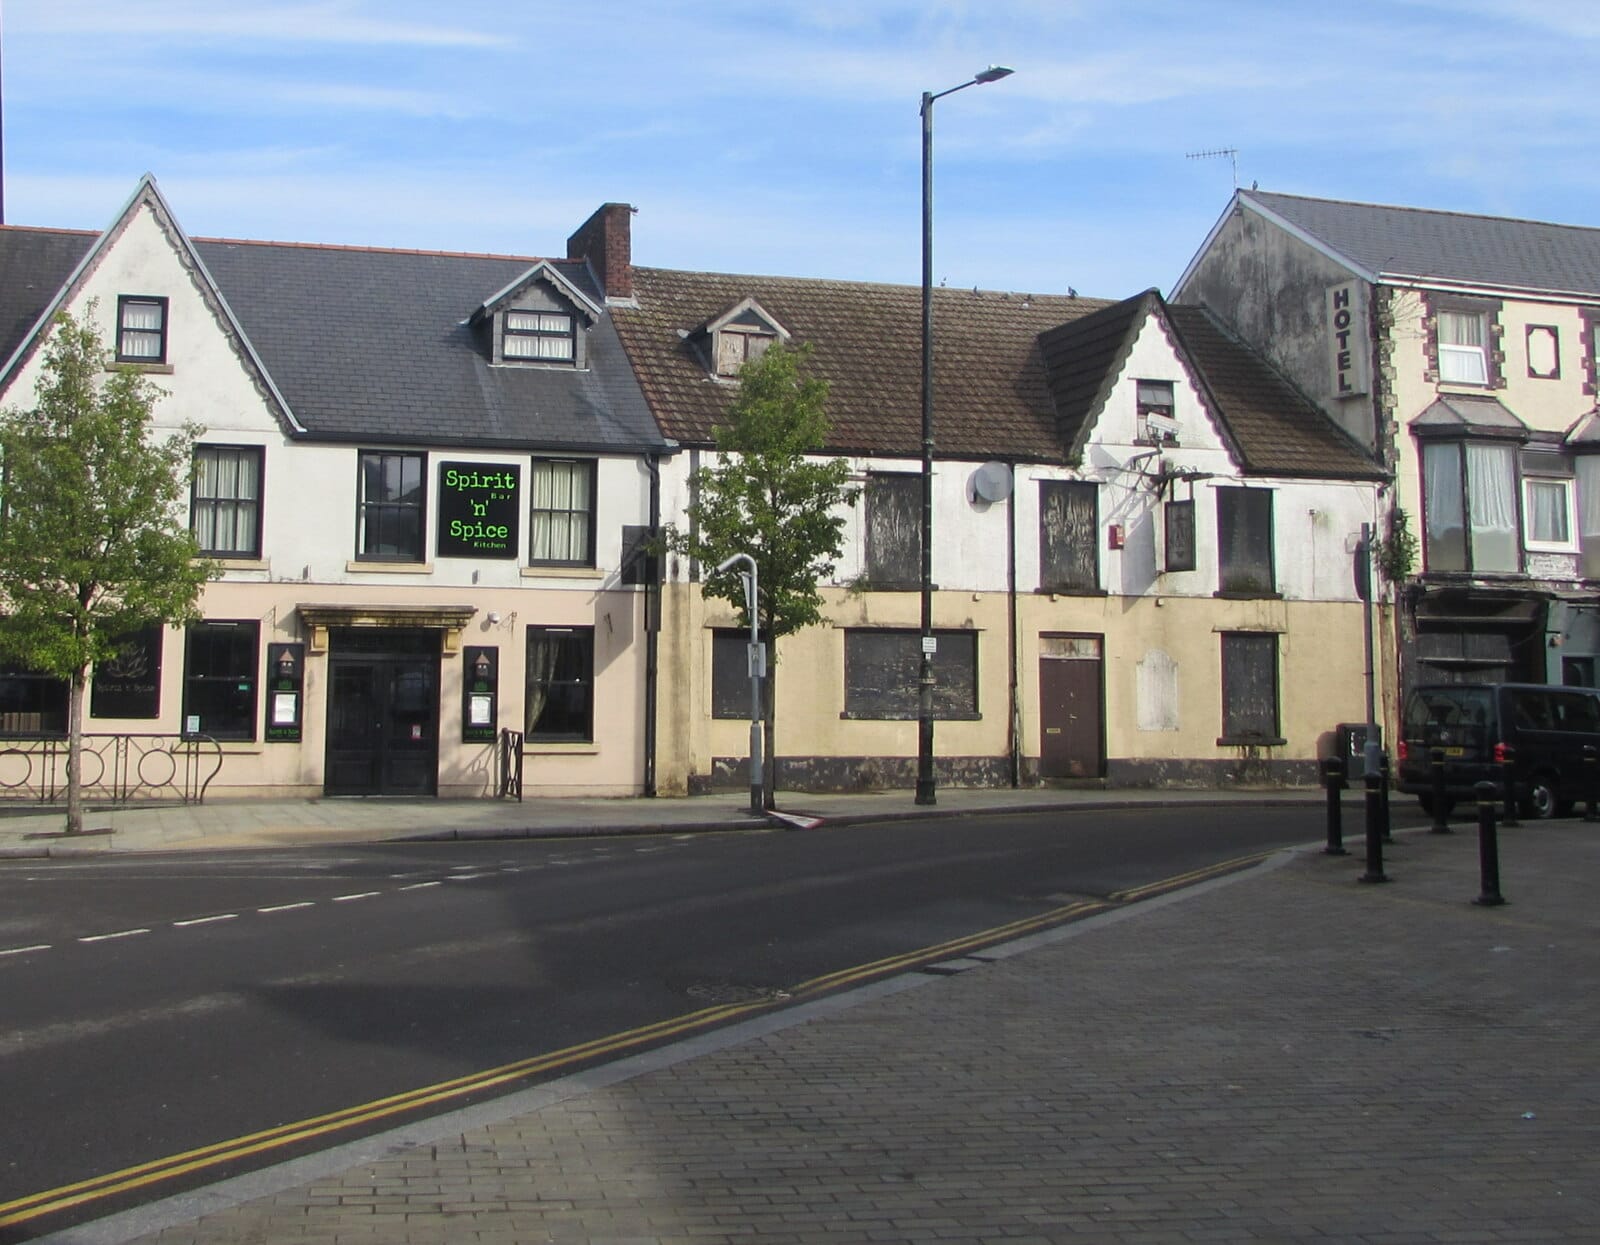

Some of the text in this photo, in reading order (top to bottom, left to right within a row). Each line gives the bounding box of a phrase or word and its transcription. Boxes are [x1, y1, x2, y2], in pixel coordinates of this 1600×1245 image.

[1333, 288, 1352, 392] HOTEL
[446, 470, 515, 491] Spirit
[490, 492, 512, 500] Bar
[470, 499, 489, 516] 'n'
[450, 520, 508, 541] Spice
[473, 541, 506, 549] Kitchen
